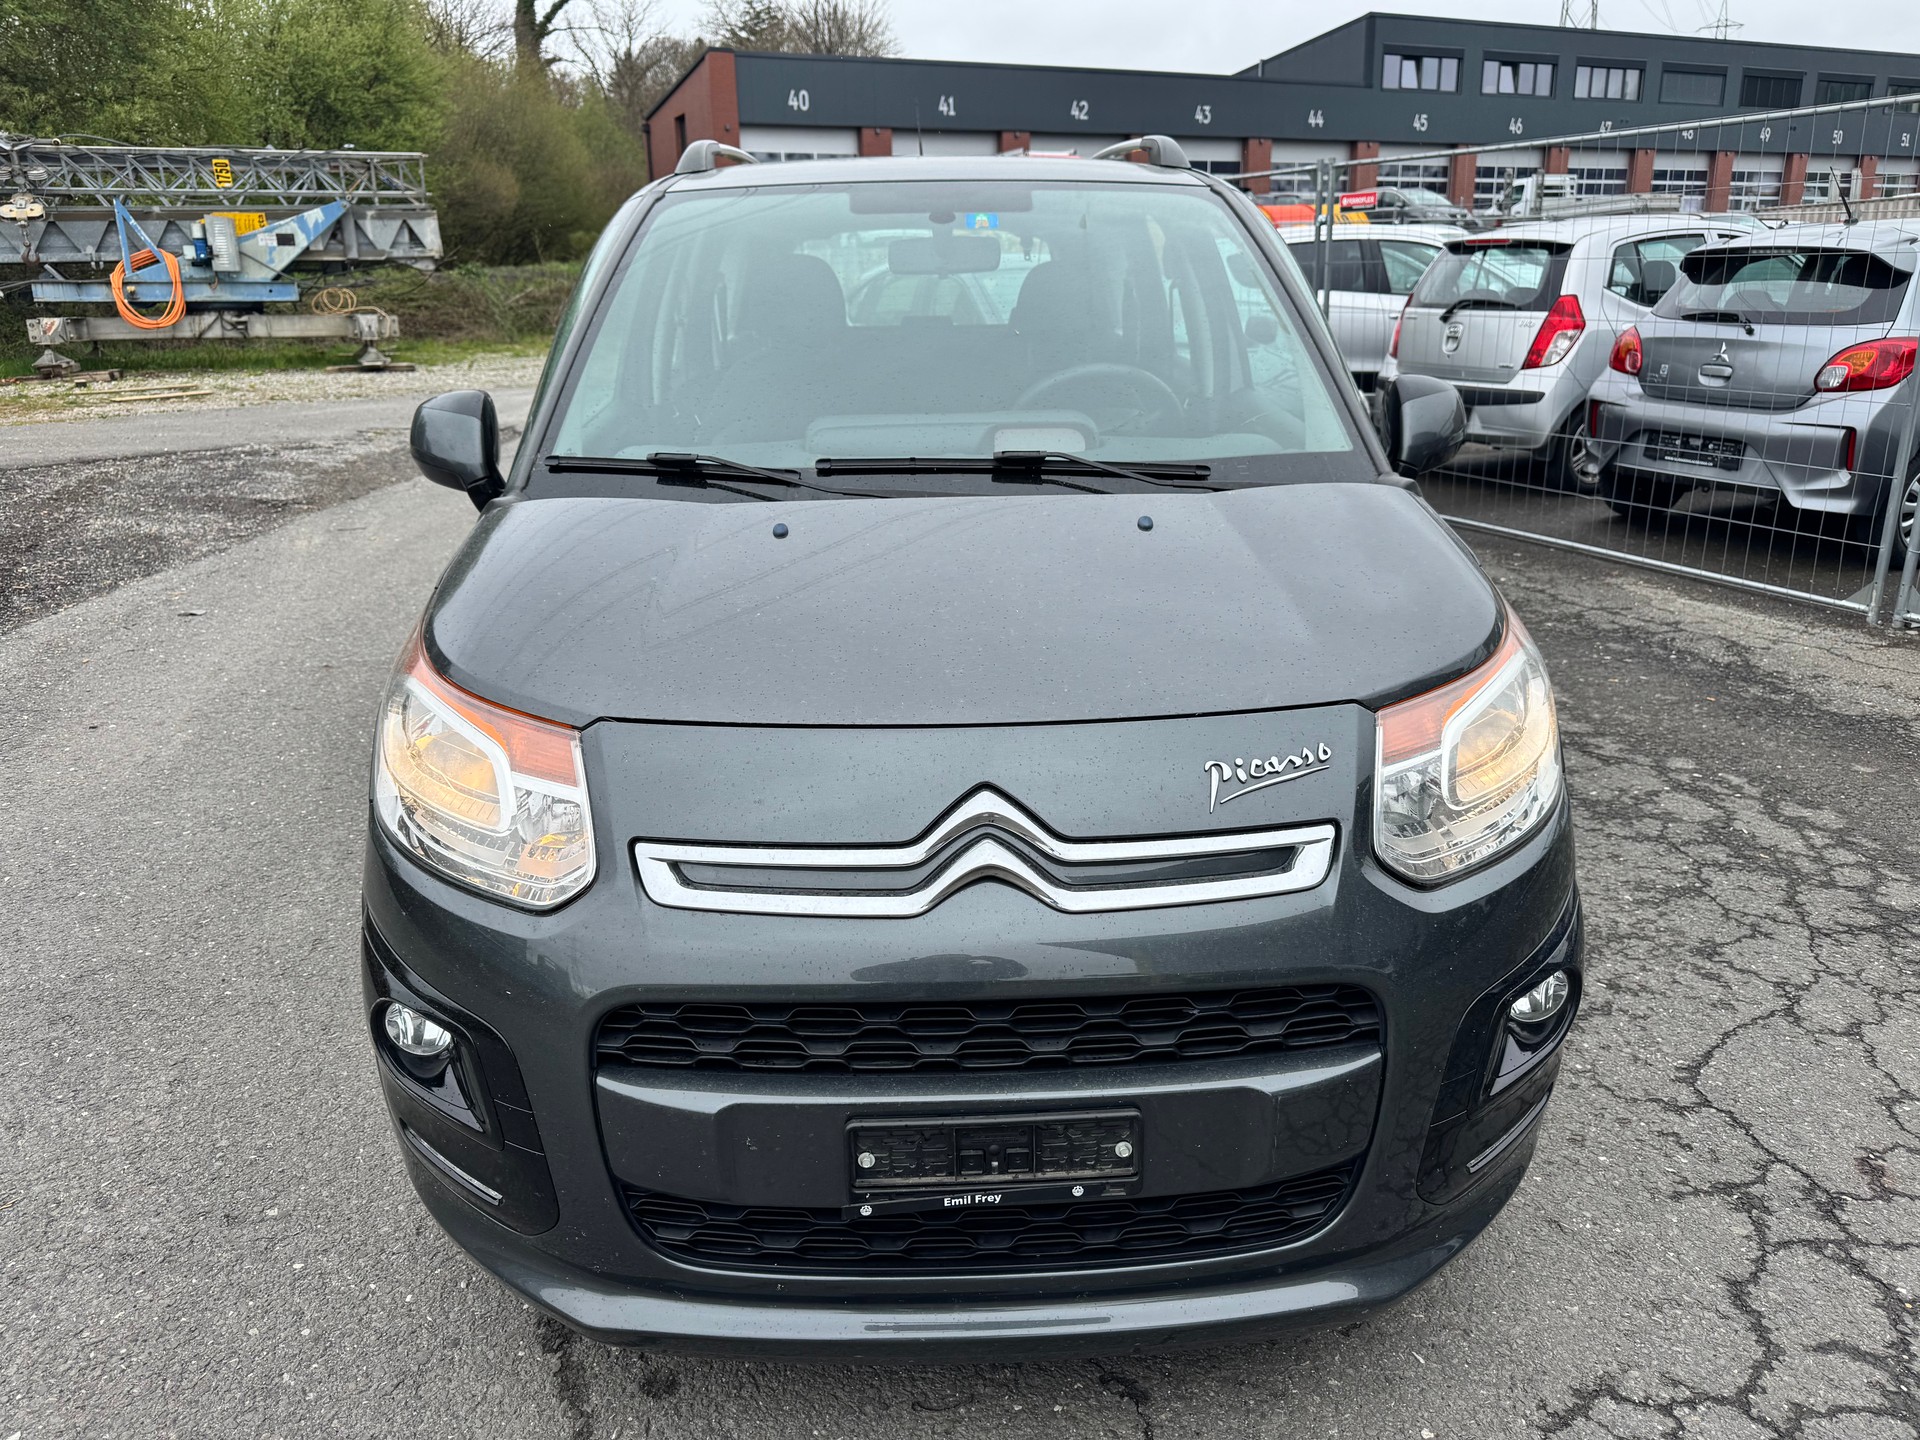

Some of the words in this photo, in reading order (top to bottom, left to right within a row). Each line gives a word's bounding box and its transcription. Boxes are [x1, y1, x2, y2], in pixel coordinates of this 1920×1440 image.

[787, 89, 810, 112] 40
[938, 95, 956, 116] 41
[1070, 99, 1089, 121] 42
[1194, 104, 1212, 125] 43
[1307, 109, 1324, 129] 44
[1412, 113, 1429, 132] 45
[1508, 117, 1523, 135] 46
[1759, 127, 1771, 142] 49
[1832, 129, 1843, 145] 50
[1900, 132, 1910, 147] 51
[214, 162, 232, 185] 1750
[943, 1195, 972, 1207] Emil
[975, 1194, 1002, 1204] Frey
